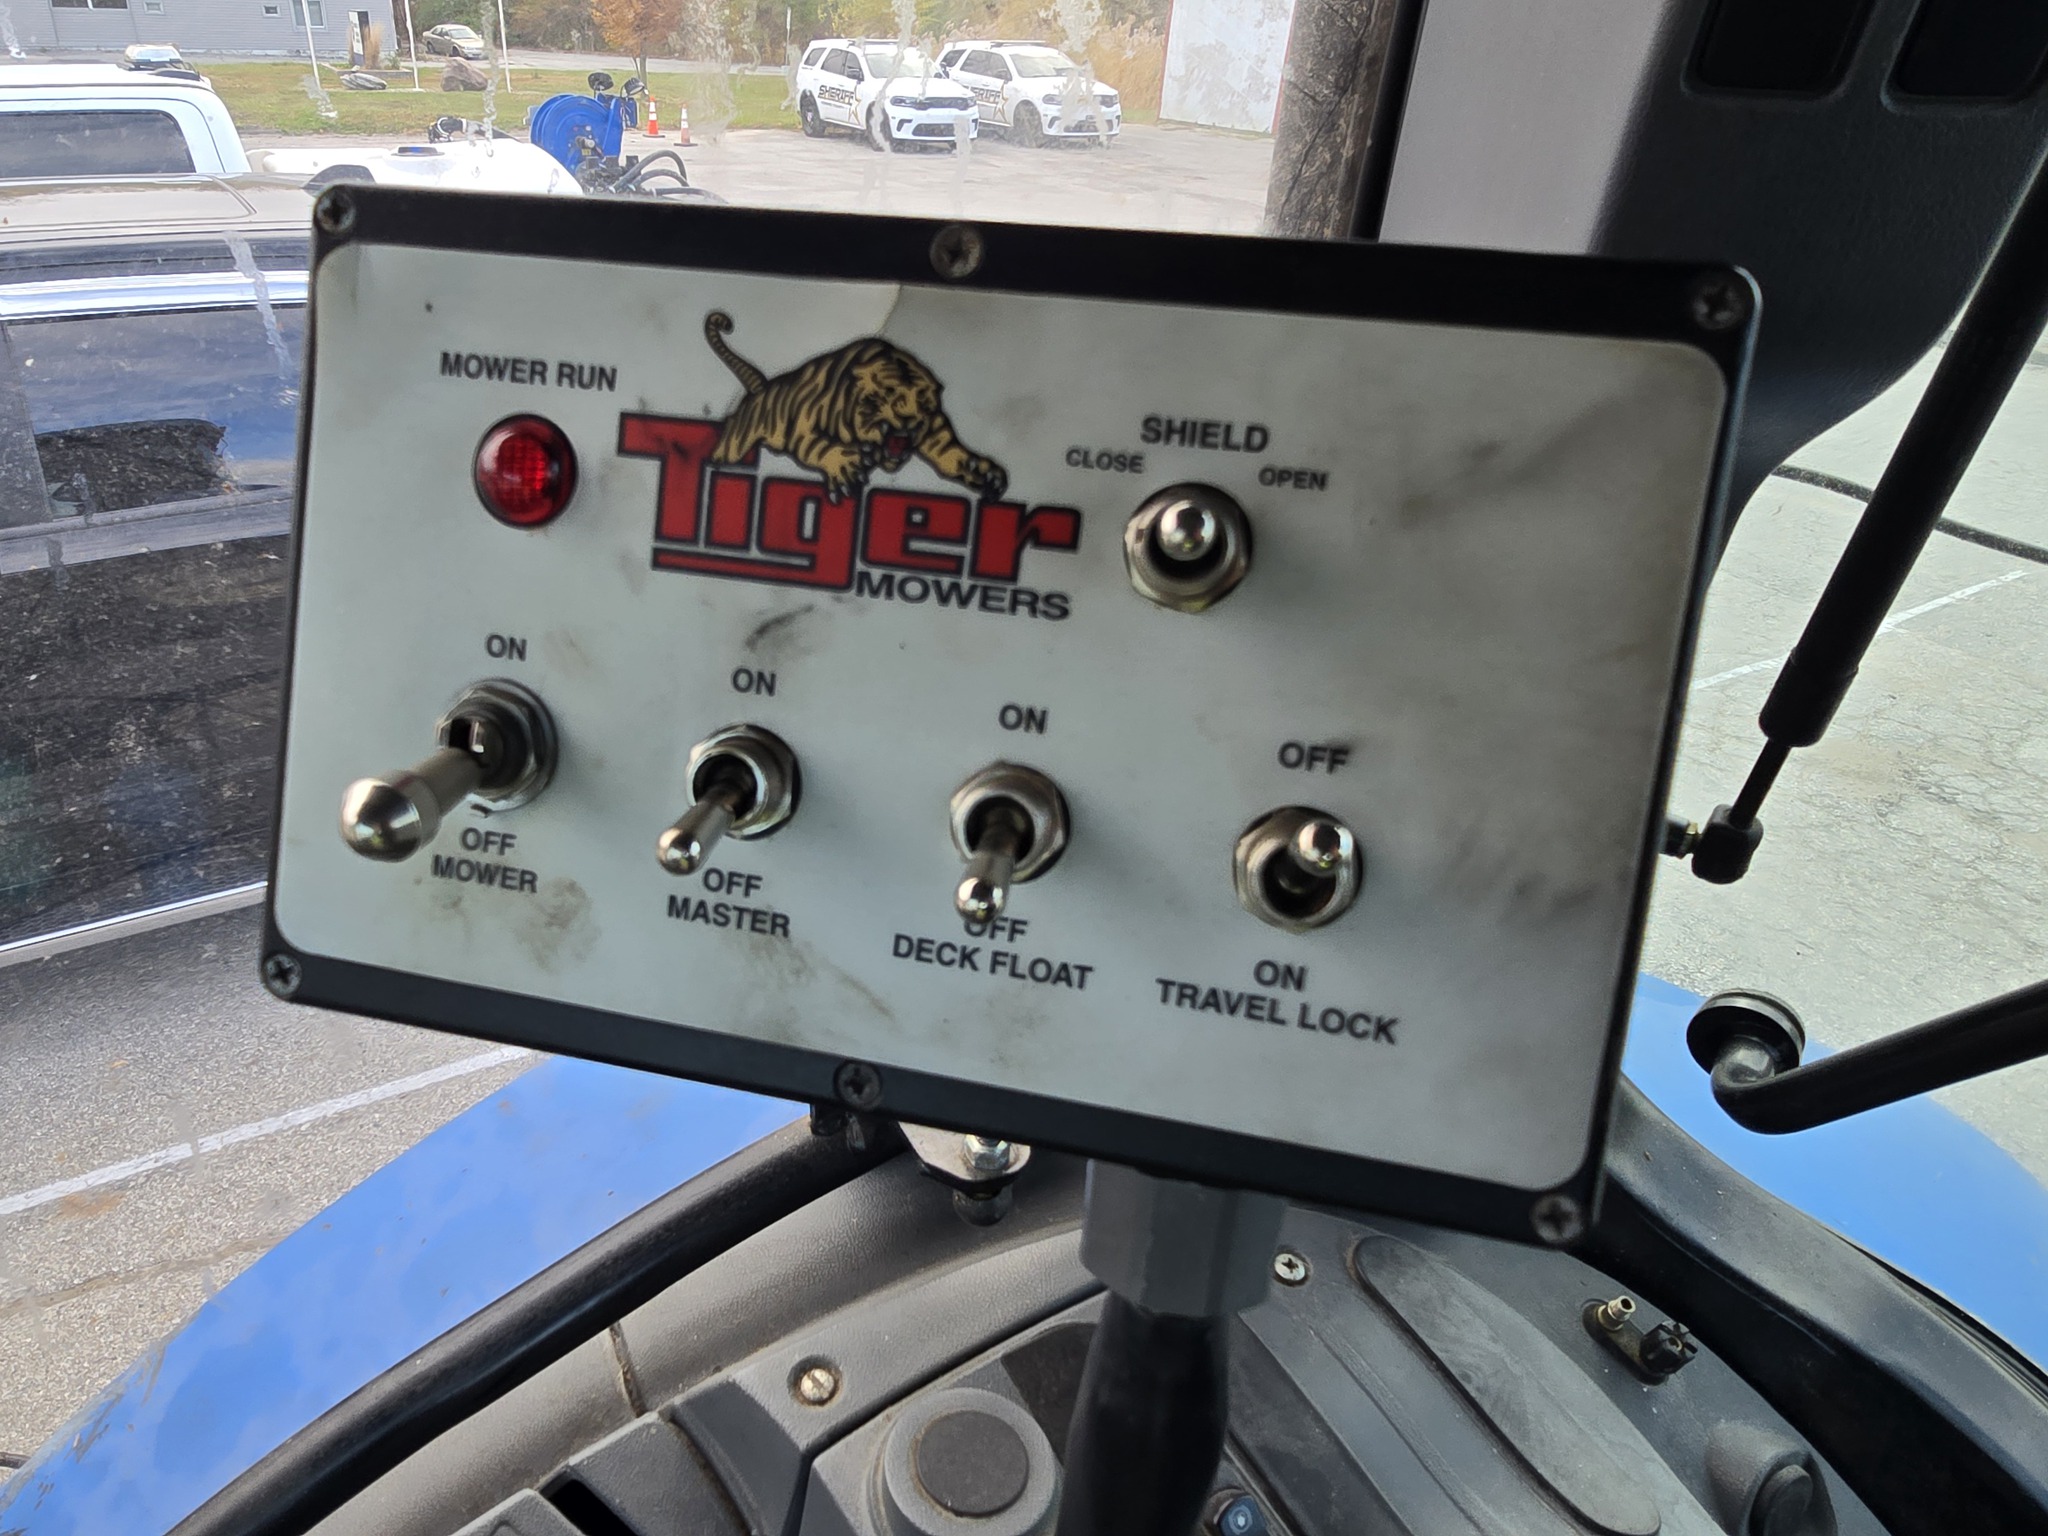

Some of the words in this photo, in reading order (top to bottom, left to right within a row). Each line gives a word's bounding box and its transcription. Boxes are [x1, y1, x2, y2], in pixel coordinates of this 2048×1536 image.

[818, 85, 854, 105] SHERIFF
[440, 352, 548, 386] MOWER
[556, 362, 618, 392] RUN
[1141, 415, 1270, 454] SHIELD
[1065, 448, 1144, 474] CLOSE
[1258, 466, 1329, 491] OPEN
[616, 412, 1081, 591] Tiger
[855, 570, 1071, 621] MOWERS
[486, 634, 527, 661] ON
[732, 668, 776, 696] ON
[1000, 704, 1048, 734] ON
[1277, 742, 1348, 774] OFF
[461, 827, 517, 856] OFF
[431, 854, 538, 893] MOWER
[703, 867, 763, 898] OFF
[667, 895, 790, 938] MASTER
[893, 933, 979, 971] DECK
[989, 951, 1094, 990] FLOAT
[1253, 960, 1305, 992] ON
[1156, 978, 1286, 1026] TRAVEL
[1298, 1003, 1398, 1045] LOCK
